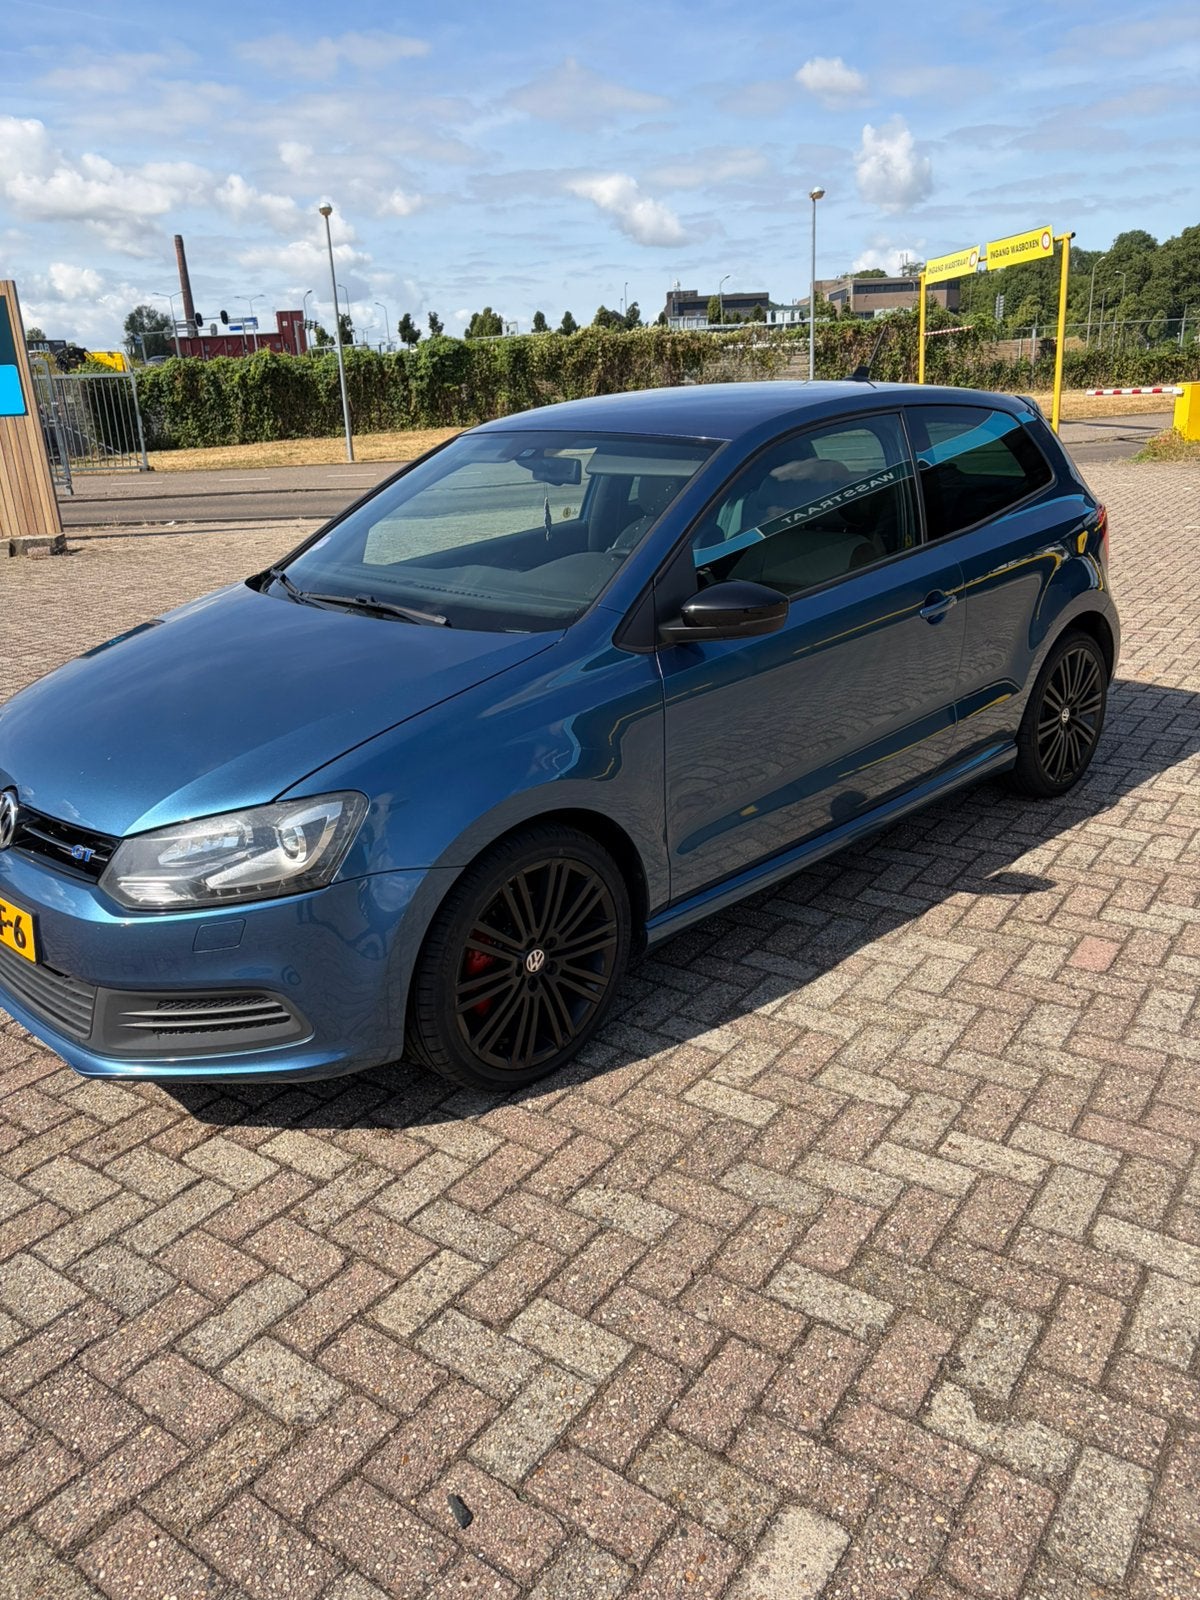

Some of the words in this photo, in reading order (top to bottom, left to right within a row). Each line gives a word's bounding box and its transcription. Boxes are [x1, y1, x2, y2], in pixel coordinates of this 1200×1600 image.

[990, 247, 1009, 259] INGANG
[1010, 239, 1039, 253] WASBOXEN
[928, 264, 944, 275] INGANG
[71, 844, 95, 862] GT
